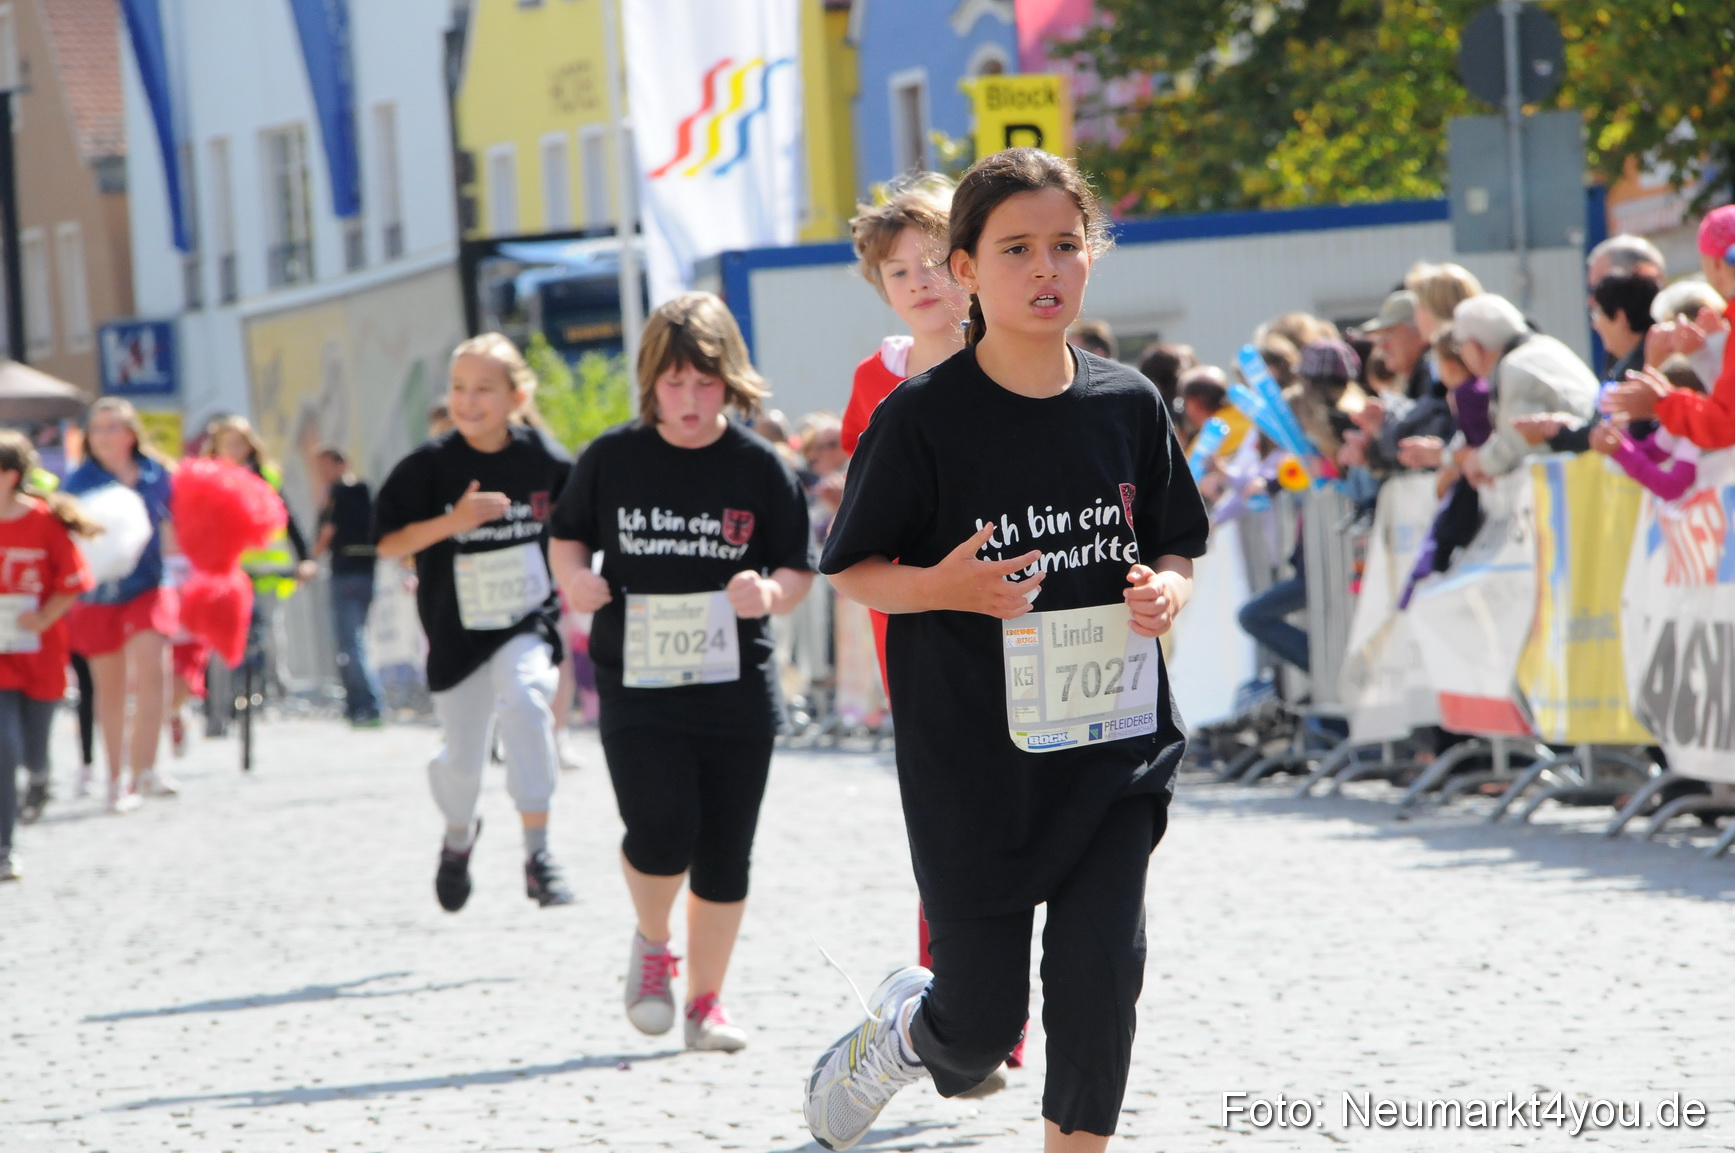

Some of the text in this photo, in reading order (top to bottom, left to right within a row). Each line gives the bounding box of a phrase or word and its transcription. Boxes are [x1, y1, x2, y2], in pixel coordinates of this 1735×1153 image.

[986, 83, 1055, 111] Block
[617, 506, 721, 536] Ich bin ein
[1027, 505, 1071, 538] bin
[1079, 497, 1120, 531] ein
[618, 531, 749, 560] Neumarkter!
[655, 627, 727, 656] 7024
[1051, 618, 1104, 648] Linda
[1055, 652, 1148, 703] 7027
[1104, 712, 1154, 732] PFLEIDERER
